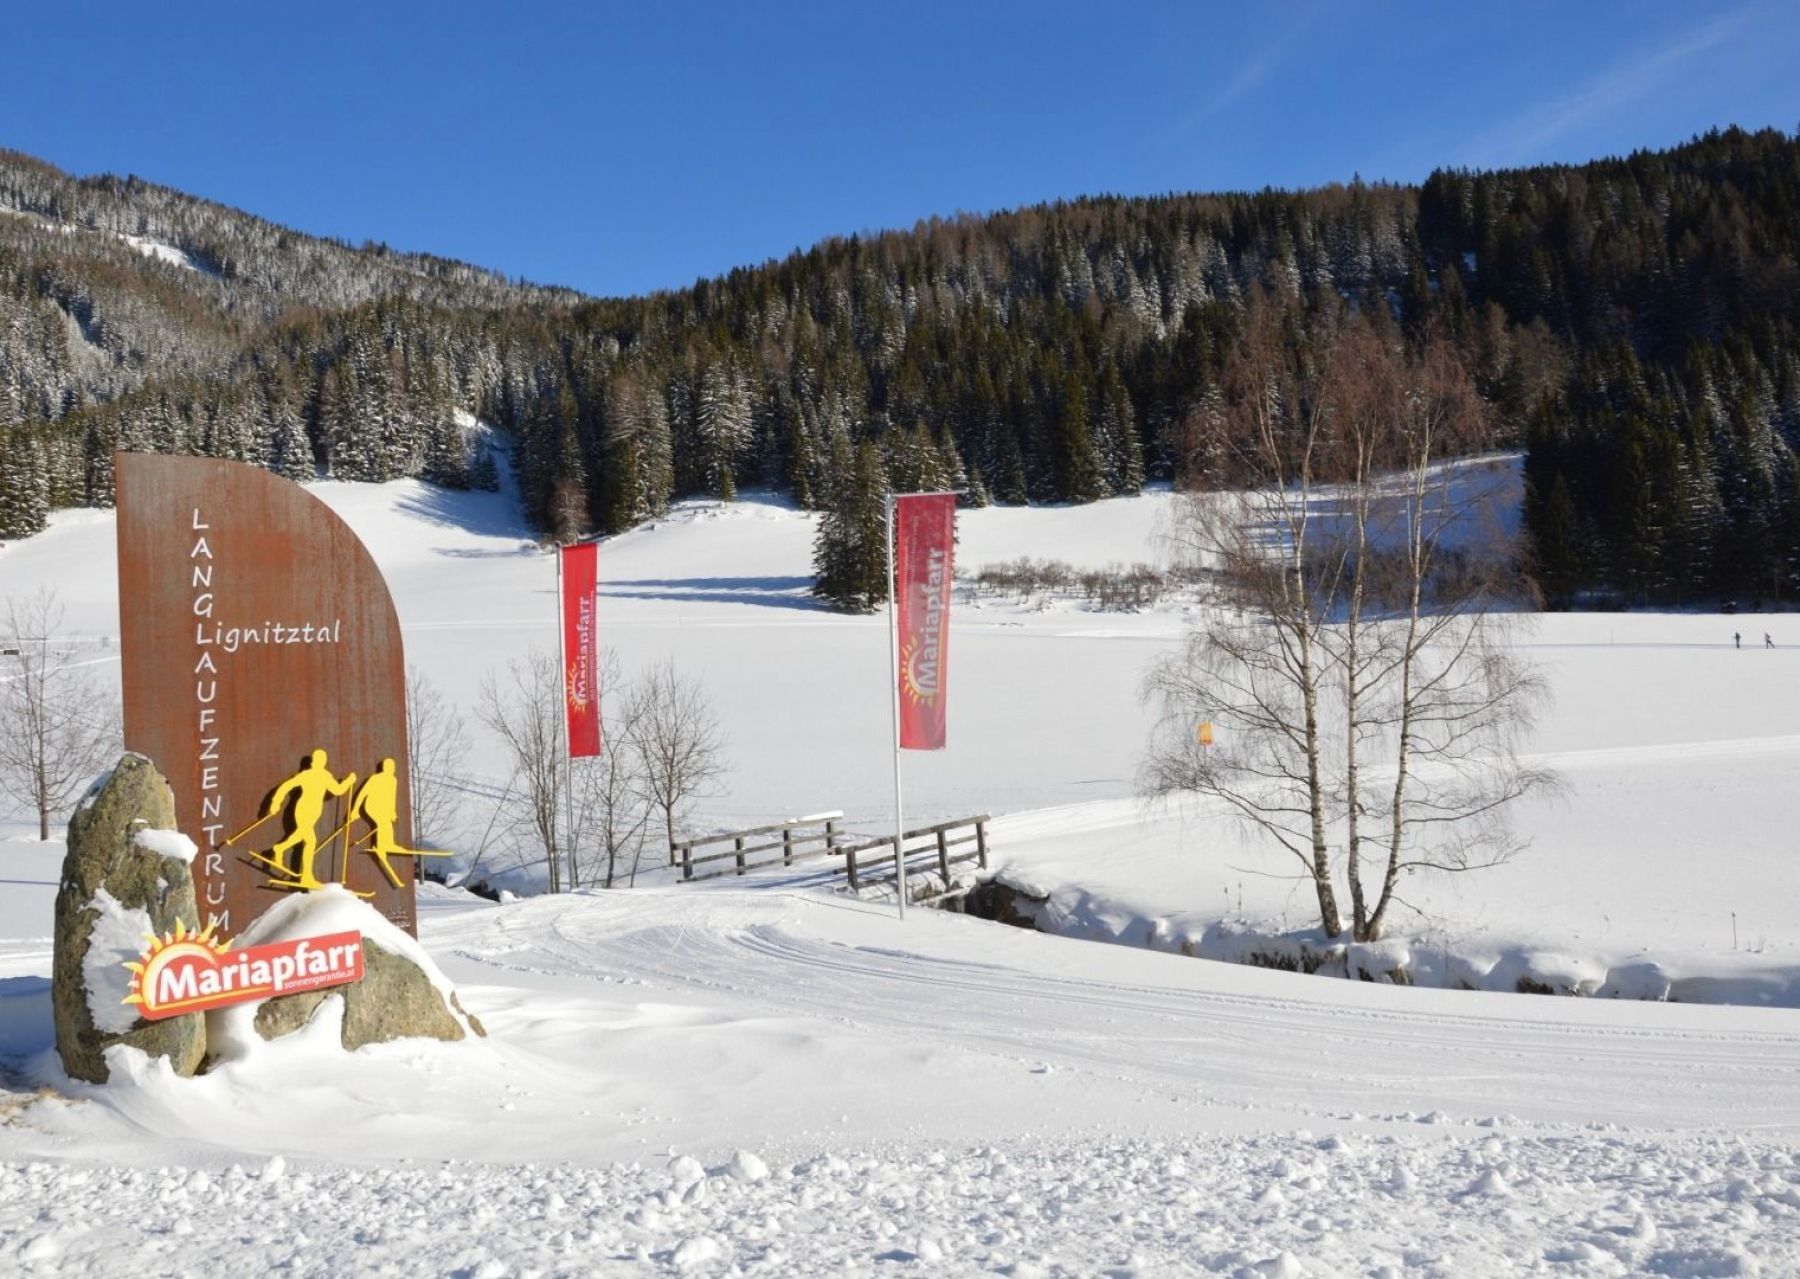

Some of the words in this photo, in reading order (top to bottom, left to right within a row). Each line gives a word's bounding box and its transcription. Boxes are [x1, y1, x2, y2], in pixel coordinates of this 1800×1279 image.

[576, 596, 591, 699] Mariapfarr
[919, 547, 946, 690] Mariapfarr
[190, 507, 229, 931] LANGLAUFZENTRUM
[158, 941, 360, 1003] Mariapfarr
[283, 968, 356, 990] sonnengarantie.at
